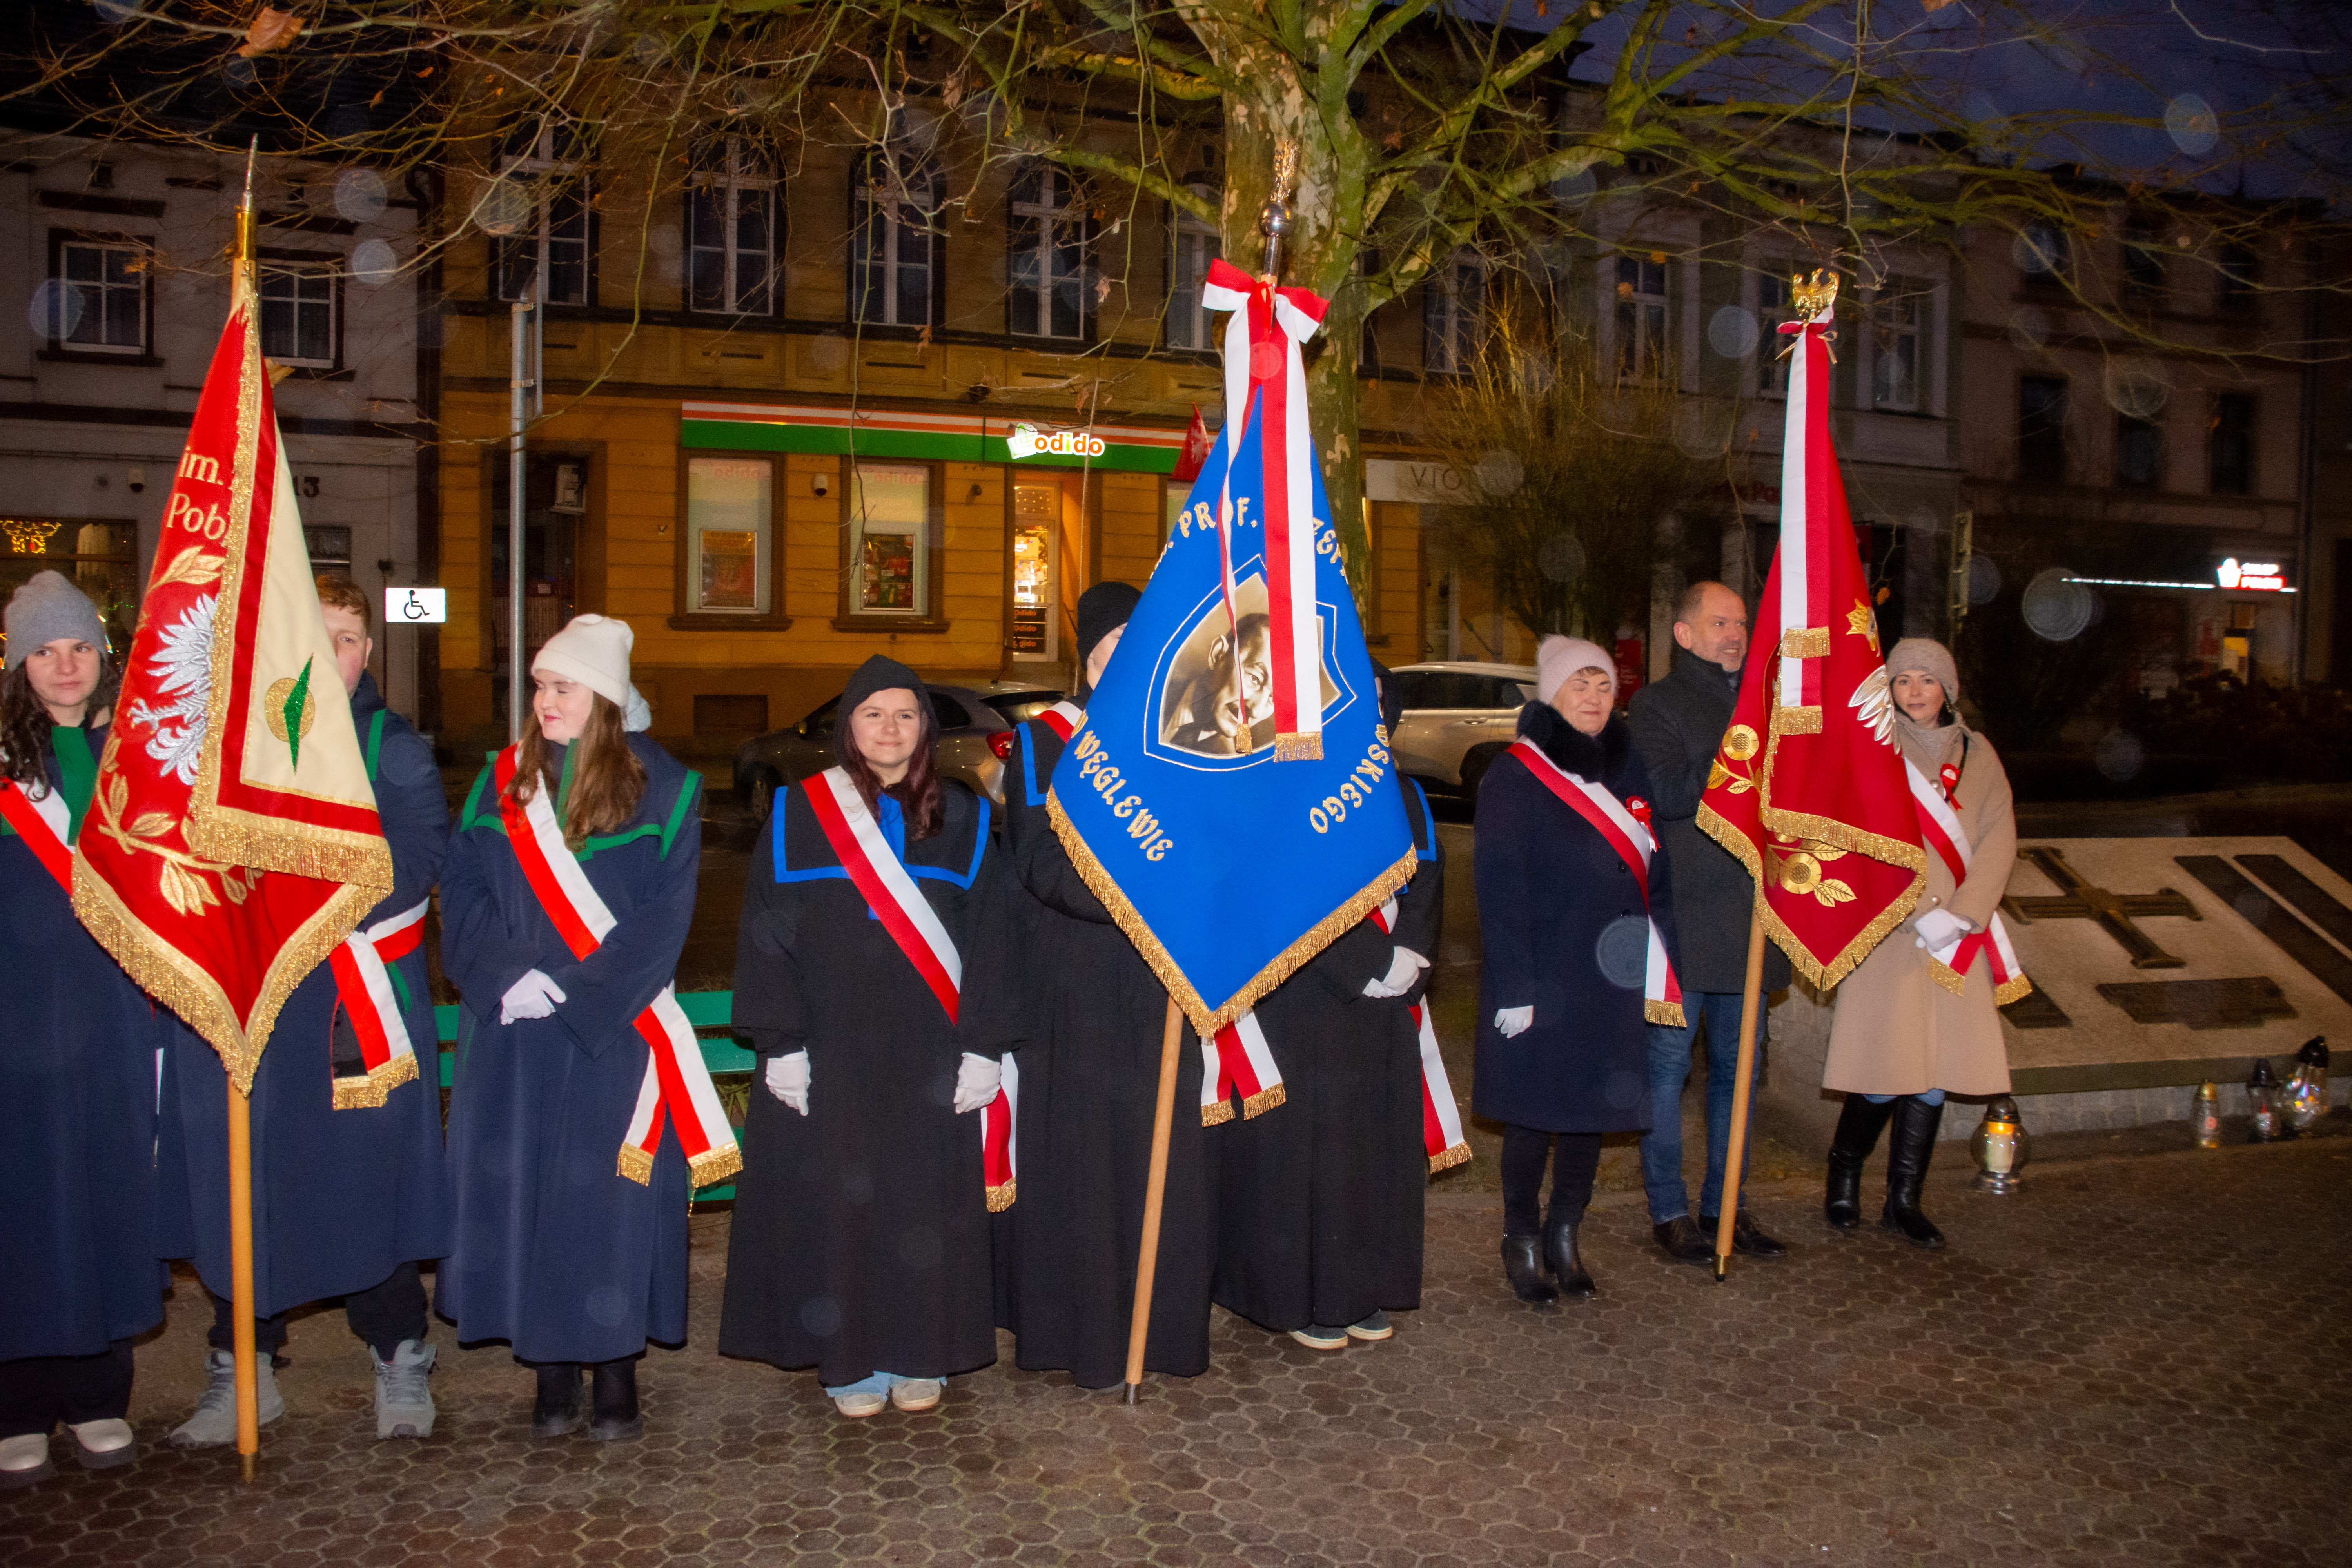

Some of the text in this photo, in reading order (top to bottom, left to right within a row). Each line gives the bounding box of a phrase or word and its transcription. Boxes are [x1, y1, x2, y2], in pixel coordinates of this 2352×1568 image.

[1034, 434, 1102, 454] odido
[178, 445, 224, 486] im.
[292, 475, 320, 498] 13
[1074, 730, 1174, 861] WĘGLEWIE
